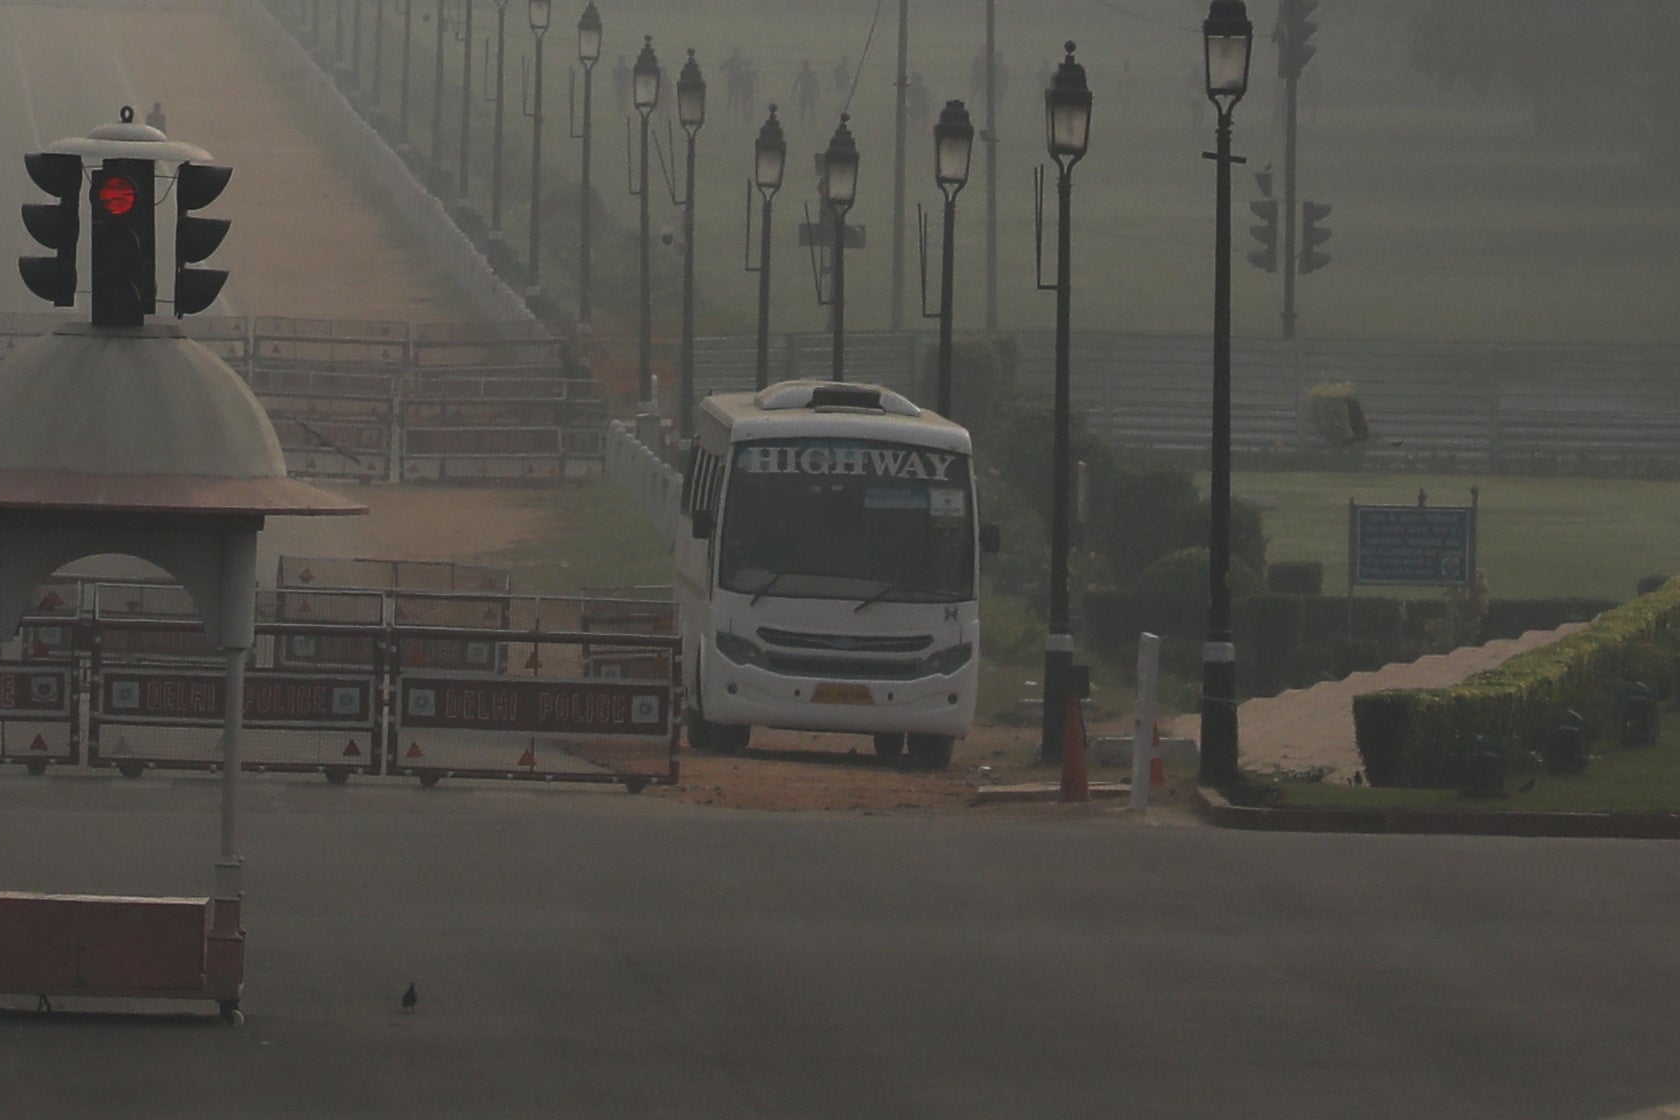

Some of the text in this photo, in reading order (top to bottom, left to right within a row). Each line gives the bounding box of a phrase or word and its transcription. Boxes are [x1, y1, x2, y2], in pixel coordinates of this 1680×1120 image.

[747, 447, 956, 481] HIGHWAY
[146, 681, 216, 712] DELHI
[446, 689, 625, 723] DELHI POLICE
